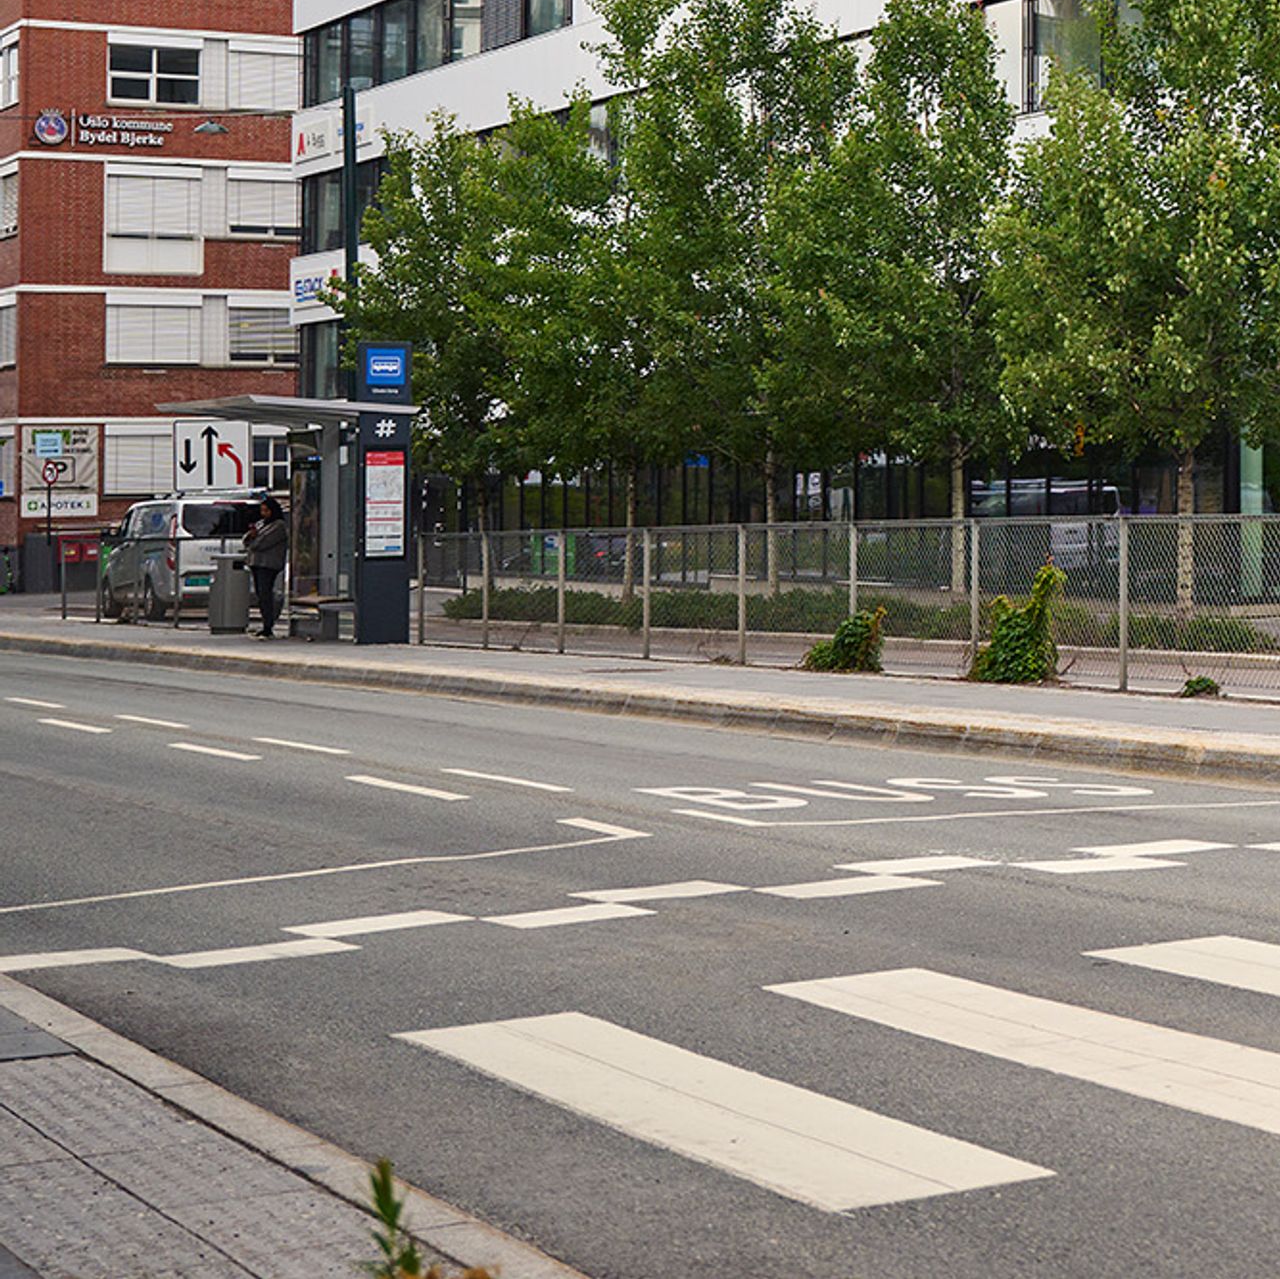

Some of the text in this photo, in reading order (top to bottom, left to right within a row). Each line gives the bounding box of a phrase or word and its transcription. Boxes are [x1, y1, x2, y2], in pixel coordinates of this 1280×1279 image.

[112, 116, 174, 132] kommune
[80, 129, 164, 147] Bydel Bjerke
[40, 501, 83, 510] AOTEK
[635, 776, 1154, 811] BUSS
